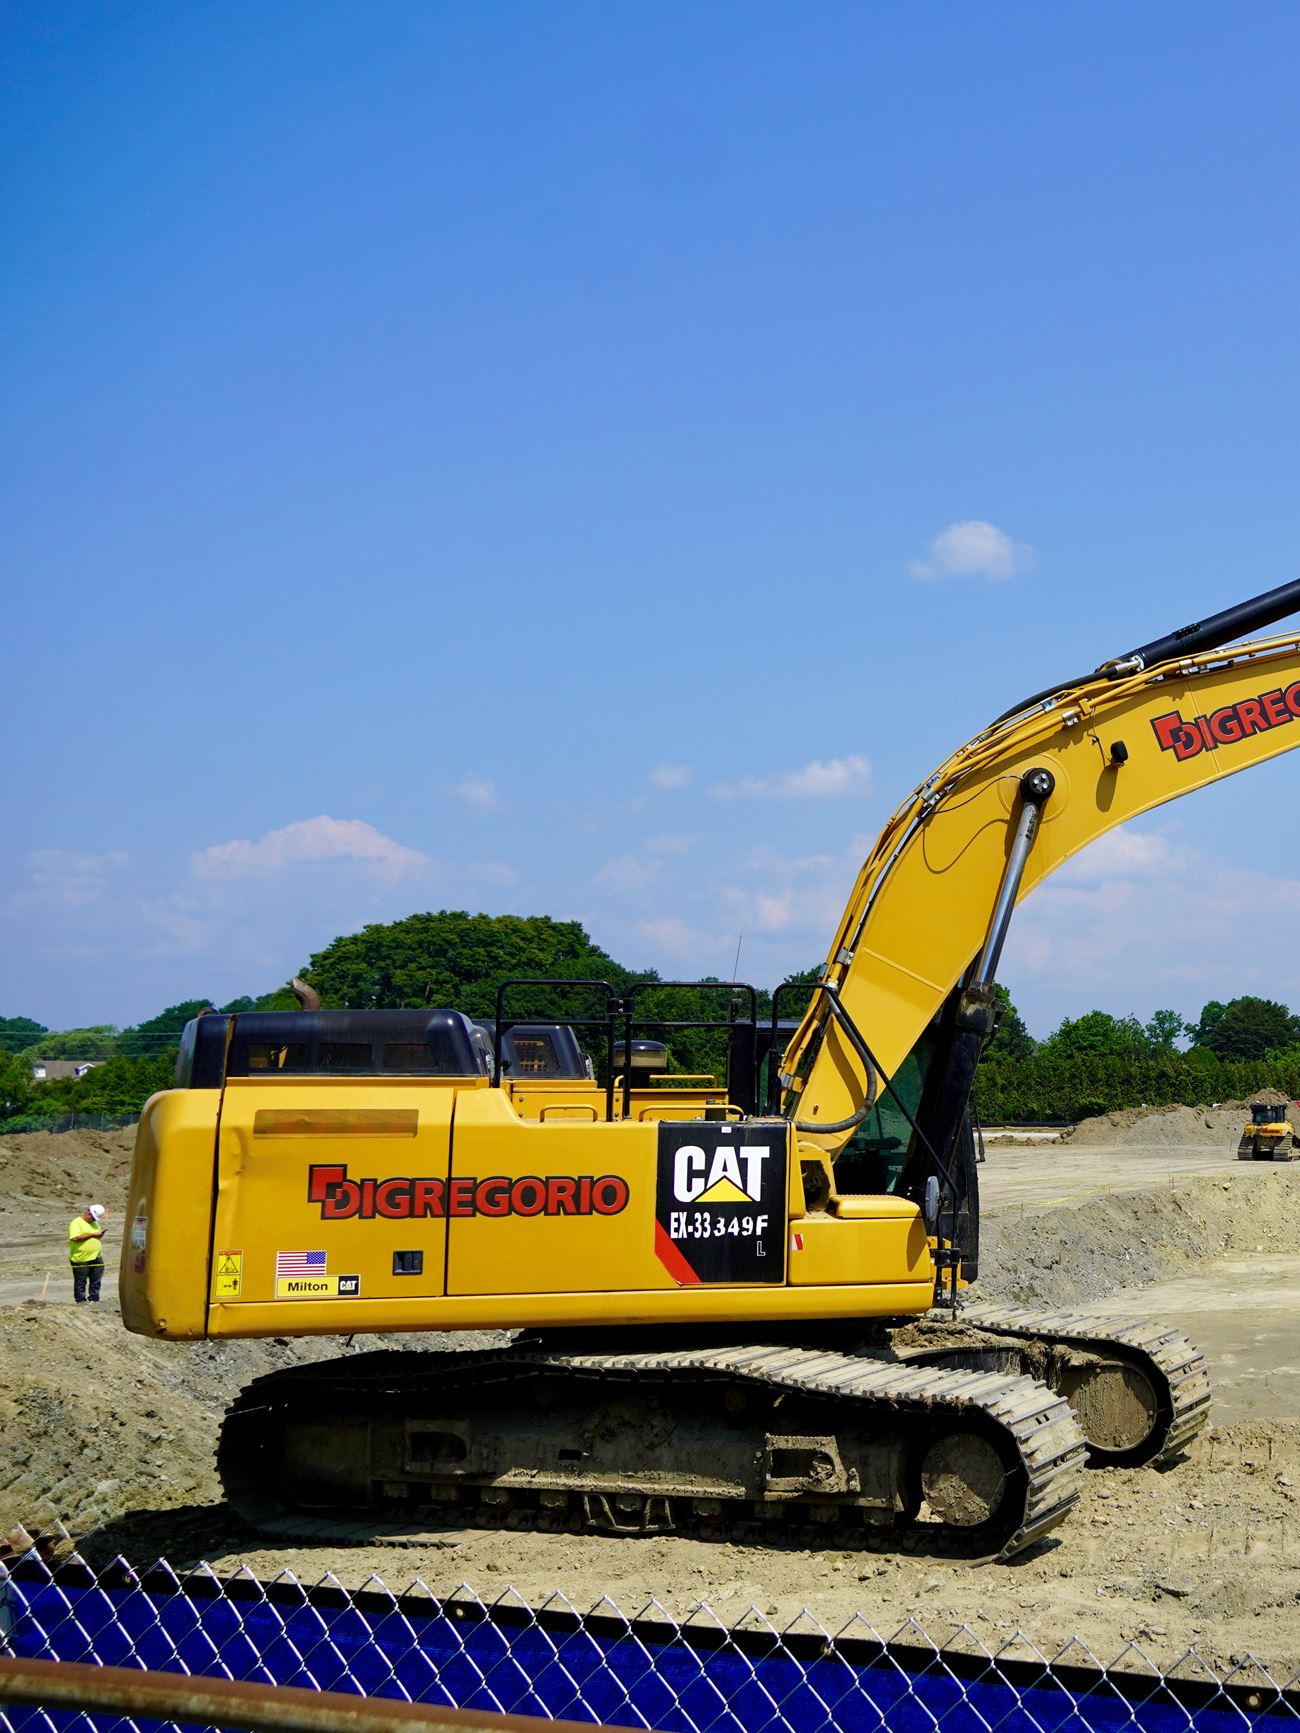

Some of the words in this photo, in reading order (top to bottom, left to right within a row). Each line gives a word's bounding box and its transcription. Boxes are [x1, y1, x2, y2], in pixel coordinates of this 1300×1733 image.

[307, 1164, 630, 1220] DIGREGORIO
[673, 1145, 770, 1203] CAT
[287, 1281, 328, 1292] Milton
[339, 1280, 358, 1291] CAT
